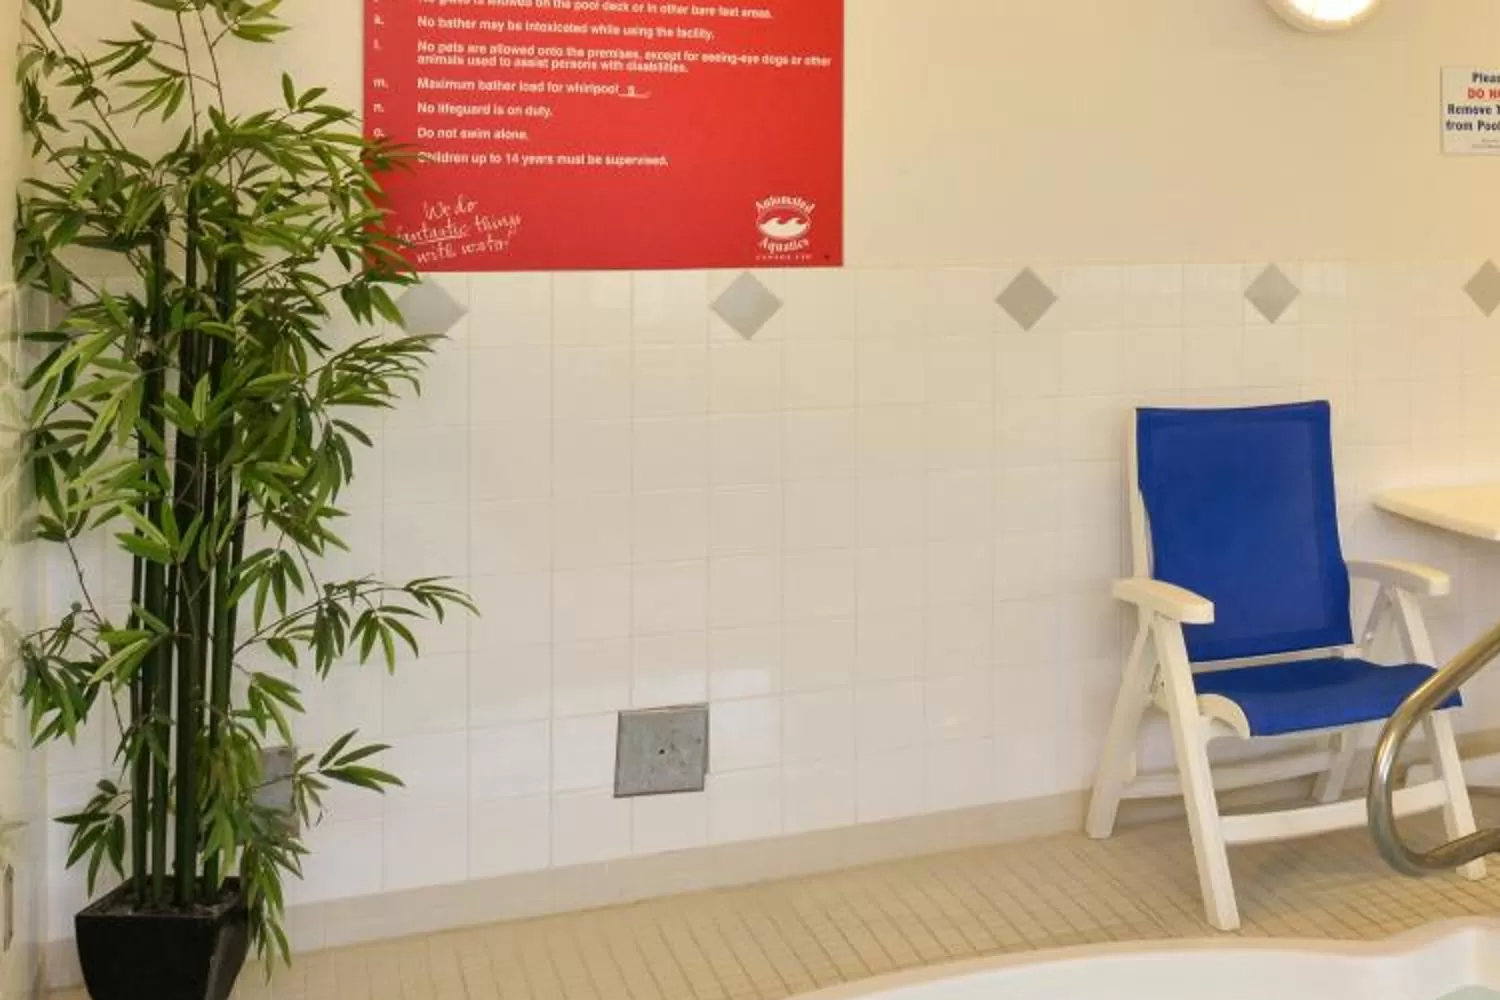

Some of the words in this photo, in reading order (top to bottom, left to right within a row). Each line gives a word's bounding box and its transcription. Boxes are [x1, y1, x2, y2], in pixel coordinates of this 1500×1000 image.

[573, 1, 600, 11] pool
[631, 3, 644, 13] or
[647, 3, 658, 13] in
[660, 4, 689, 14] other
[417, 15, 435, 27] No
[438, 16, 477, 29] bather
[480, 20, 504, 32] may
[508, 20, 522, 31] be
[525, 21, 587, 33] intoxicated
[591, 24, 620, 35] while
[623, 27, 654, 39] using
[656, 27, 673, 37] the
[676, 27, 716, 41] facility.
[417, 40, 435, 52] No
[438, 42, 464, 54] pets
[467, 44, 487, 54] are
[489, 43, 535, 56] allowed
[537, 46, 563, 57] onto
[566, 46, 585, 57] the
[645, 51, 681, 63] except
[683, 51, 700, 62] for
[701, 53, 760, 66] seeing-eye
[761, 54, 789, 68] dogs
[791, 56, 802, 65] or
[803, 56, 833, 68] other
[417, 55, 465, 65] animals
[467, 56, 497, 67] used
[499, 57, 511, 67] to
[514, 58, 549, 68] assist
[551, 60, 598, 71] persons
[600, 60, 624, 71] with
[626, 61, 688, 73] disabilities.
[417, 77, 475, 90] Maximum
[477, 80, 516, 92] bather
[519, 80, 544, 92] load
[547, 81, 564, 92] for
[566, 82, 619, 96] whirlpool
[1467, 87, 1485, 99] DO
[417, 102, 435, 113] No
[437, 102, 490, 117] lifeguard
[493, 104, 504, 115] is
[507, 106, 522, 115] on
[524, 105, 552, 118] duty.
[1447, 104, 1492, 115] Remove
[417, 128, 435, 138] Do
[437, 128, 457, 138] not
[459, 129, 491, 139] swim
[493, 129, 528, 140] alone.
[1445, 120, 1473, 131] from
[471, 153, 487, 166] up
[489, 153, 502, 163] to
[506, 152, 519, 163] 14
[521, 154, 553, 166] years
[556, 154, 585, 165] must
[587, 154, 602, 165] be
[454, 194, 478, 215] do
[475, 214, 521, 234] things
[417, 241, 456, 265] with
